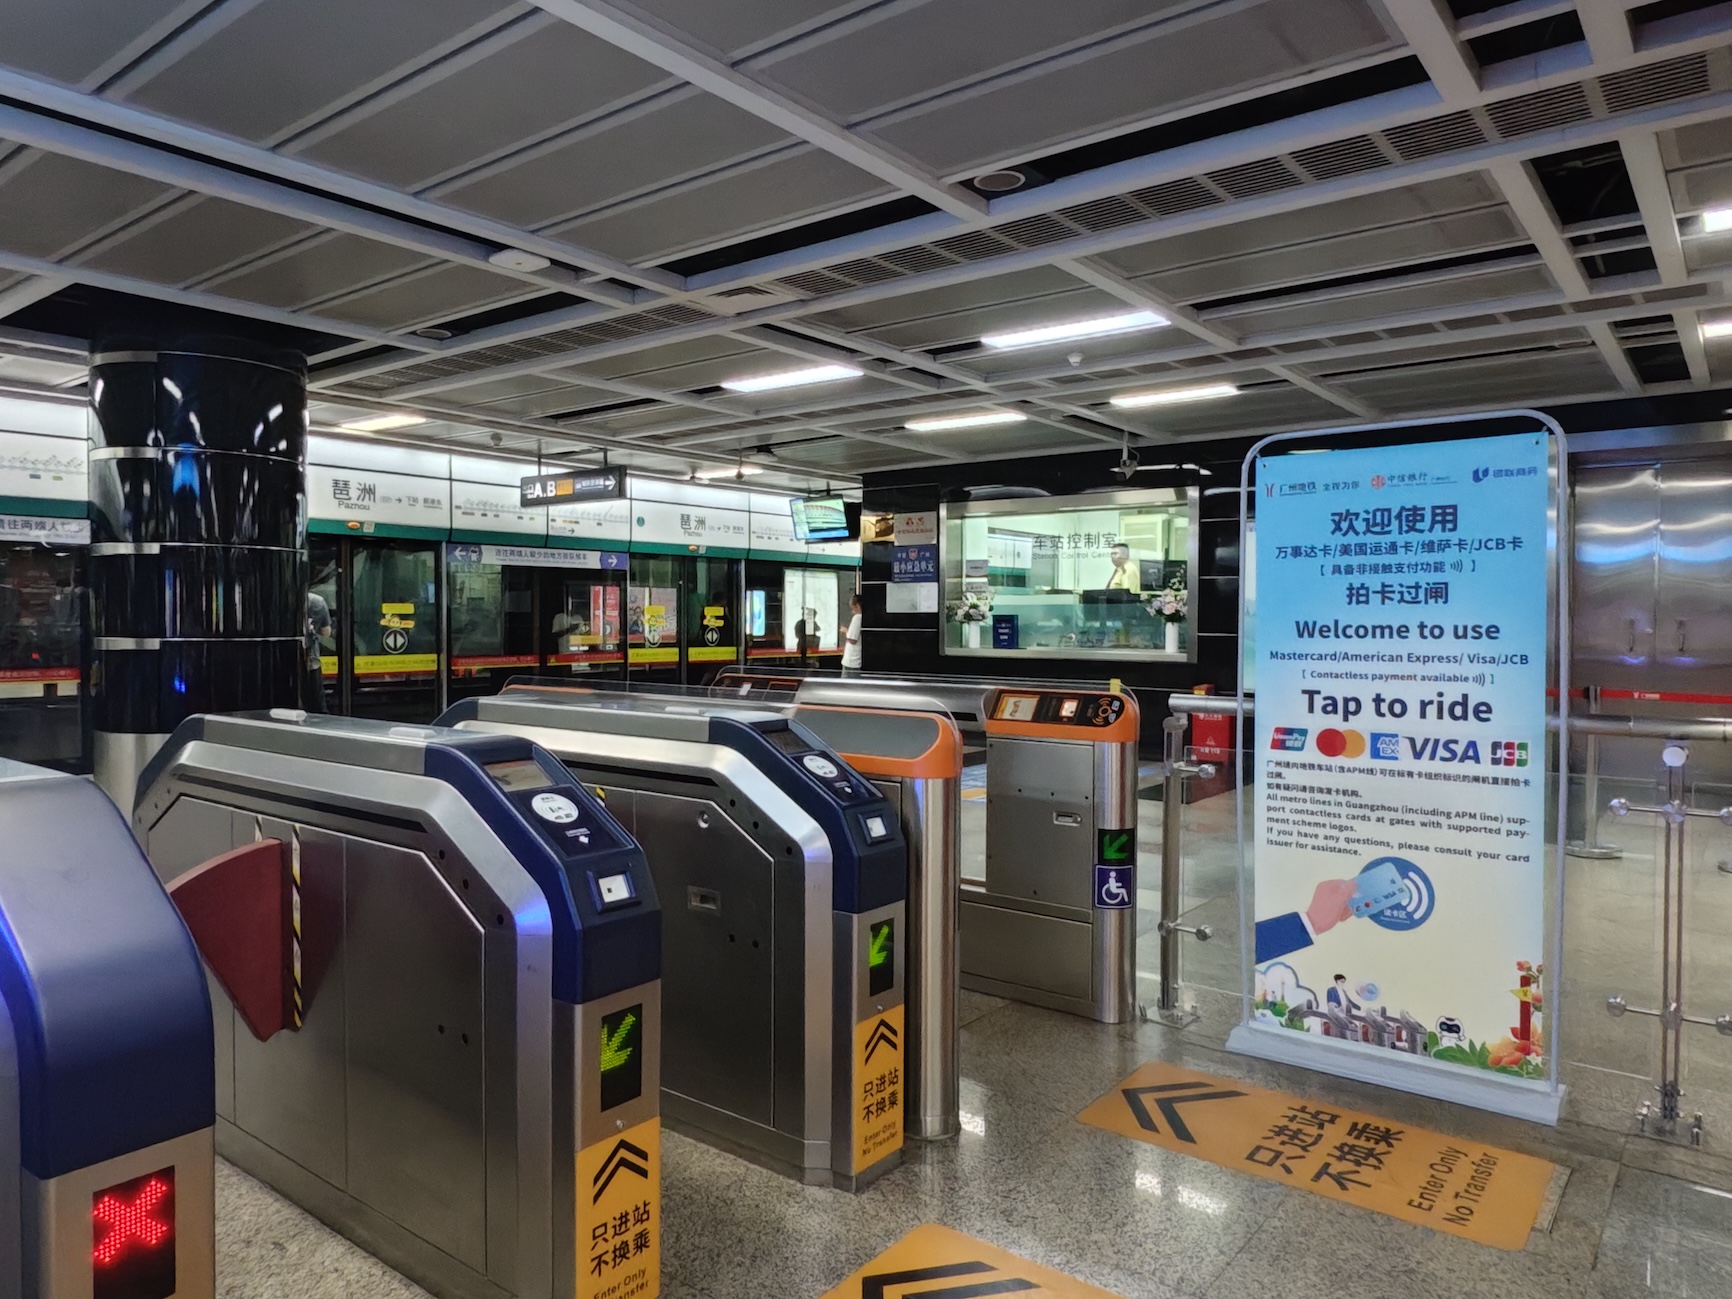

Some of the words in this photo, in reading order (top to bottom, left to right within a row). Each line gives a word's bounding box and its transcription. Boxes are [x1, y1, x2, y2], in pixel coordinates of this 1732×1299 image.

[331, 478, 376, 503] 琶洲
[1330, 504, 1458, 537] 欢迎使用
[1033, 532, 1117, 550] 车站控制室
[1275, 536, 1523, 559] 万事达卡/美国运通卡/维萨卡/JCB卡
[1331, 561, 1446, 576] 具备非接触支付功能
[1346, 581, 1449, 606] 拍卡过闸
[1295, 619, 1410, 640] Welcome
[1417, 621, 1444, 640] to
[1453, 624, 1501, 640] use
[1270, 650, 1403, 663] Mastercard/American
[1310, 670, 1369, 680] Contactless
[1371, 673, 1417, 682] payment
[1420, 674, 1470, 682] available
[1301, 689, 1362, 722] Tap
[1372, 693, 1408, 718] to
[1420, 691, 1492, 722] ride
[1402, 736, 1481, 764] VISA
[1266, 805, 1286, 813] port
[1290, 808, 1342, 819] contactless
[1346, 813, 1372, 822] cards
[1376, 816, 1385, 824] at
[1389, 818, 1416, 826] gates
[1420, 819, 1442, 829] with
[1446, 822, 1502, 834] supported
[1506, 828, 1531, 839] pay-
[1280, 795, 1308, 804] metro
[1310, 796, 1332, 806] lines
[1334, 798, 1342, 808] in
[1346, 800, 1399, 812] Guangzhou
[1402, 805, 1452, 819] (including
[1454, 811, 1477, 820] APM
[1480, 812, 1504, 824] line)
[1506, 816, 1531, 826] sup-
[1266, 816, 1290, 825] ment
[1292, 818, 1327, 829] scheme
[1330, 822, 1357, 832] logos.
[1266, 826, 1274, 834] If
[1297, 830, 1320, 840] have
[1323, 834, 1340, 844] any
[1344, 836, 1394, 849] questions,
[1398, 842, 1430, 852] please
[1434, 846, 1472, 857] consult
[1476, 850, 1502, 860] your
[1506, 854, 1530, 862] card
[1266, 838, 1293, 847] issuer
[1296, 840, 1308, 849] for
[1311, 844, 1362, 856] assistance.
[864, 1067, 899, 1102] 只进站
[862, 1089, 898, 1124] 不换乘
[864, 1130, 882, 1145] Enter
[872, 1130, 898, 1152] Transfer
[1244, 1105, 1343, 1174] 只进站
[1310, 1122, 1404, 1191] 不换乘
[1408, 1174, 1445, 1212] Enter
[1428, 1146, 1469, 1176] Only
[1454, 1152, 1500, 1204] Transfer
[591, 1200, 651, 1251] 只进站
[1442, 1204, 1474, 1227] No
[590, 1228, 650, 1278] 不换乘
[624, 1268, 646, 1286] Only
